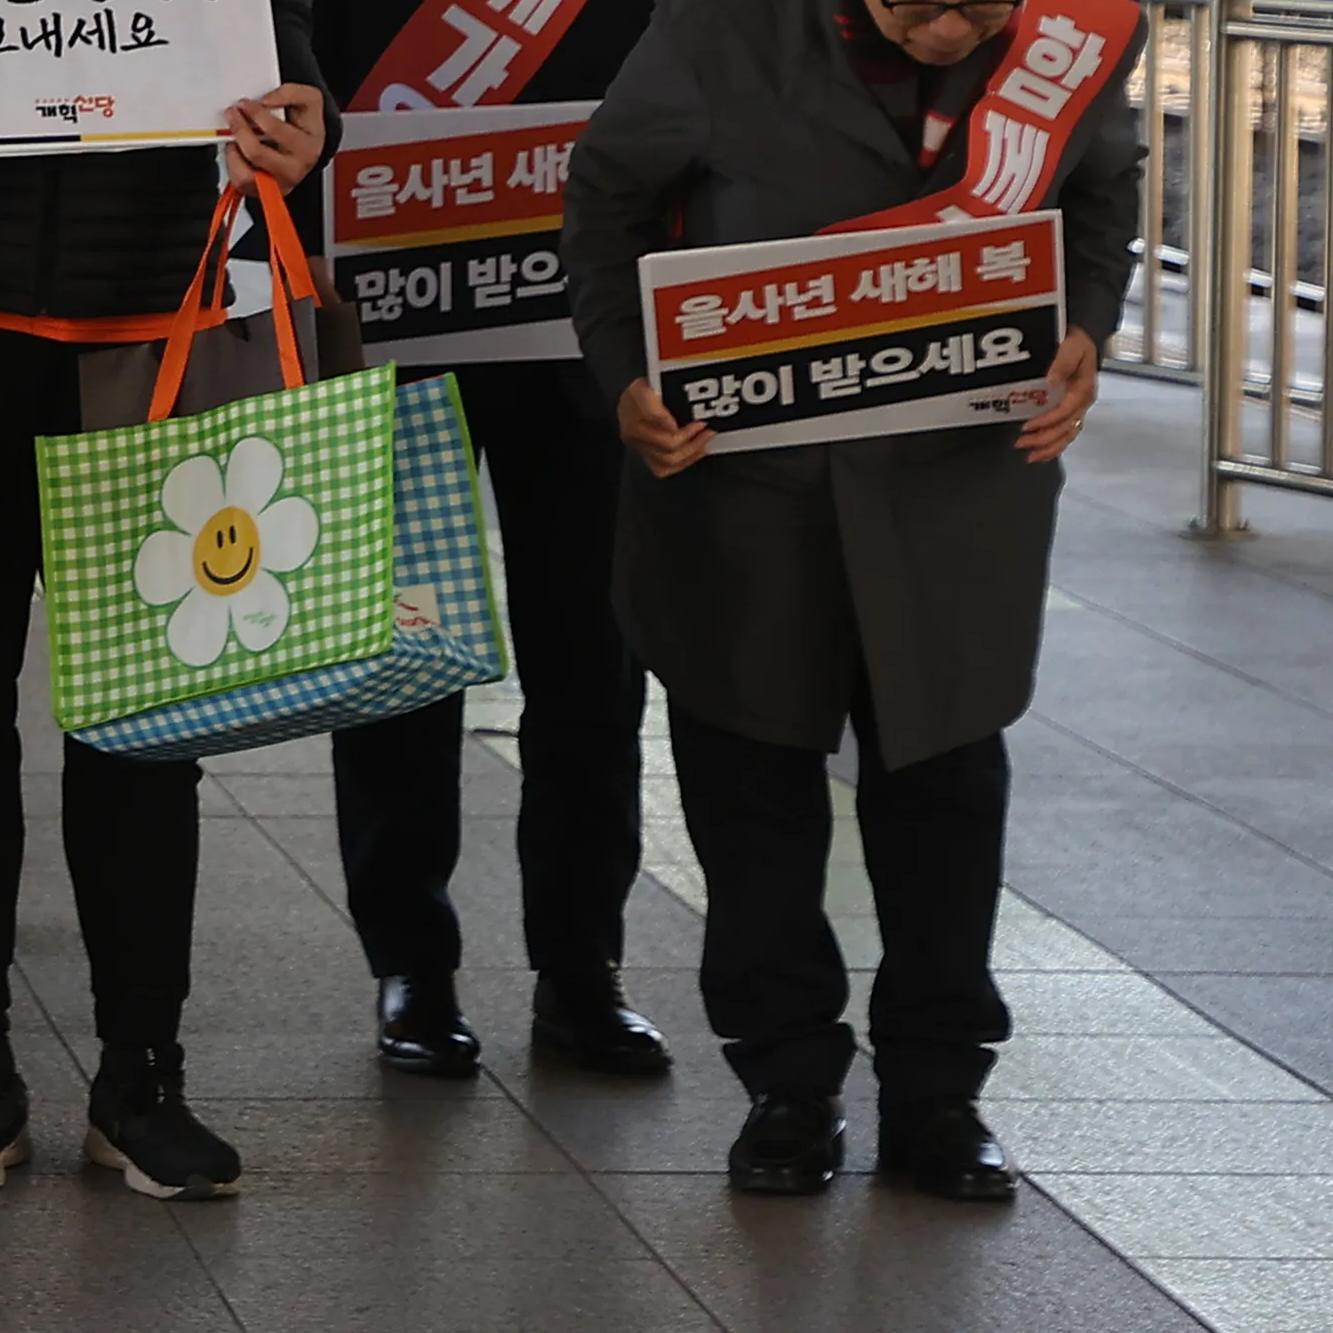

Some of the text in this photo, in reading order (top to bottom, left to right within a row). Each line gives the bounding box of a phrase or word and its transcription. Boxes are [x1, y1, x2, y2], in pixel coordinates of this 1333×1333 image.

[35, 95, 115, 124] 개혁신당
[939, 13, 1107, 223] 함께
[351, 152, 495, 219] 을사년
[354, 250, 569, 324] 많이 받으
[675, 239, 1032, 342] 을사년 새해 복
[684, 326, 1031, 422] 많이 받으세요
